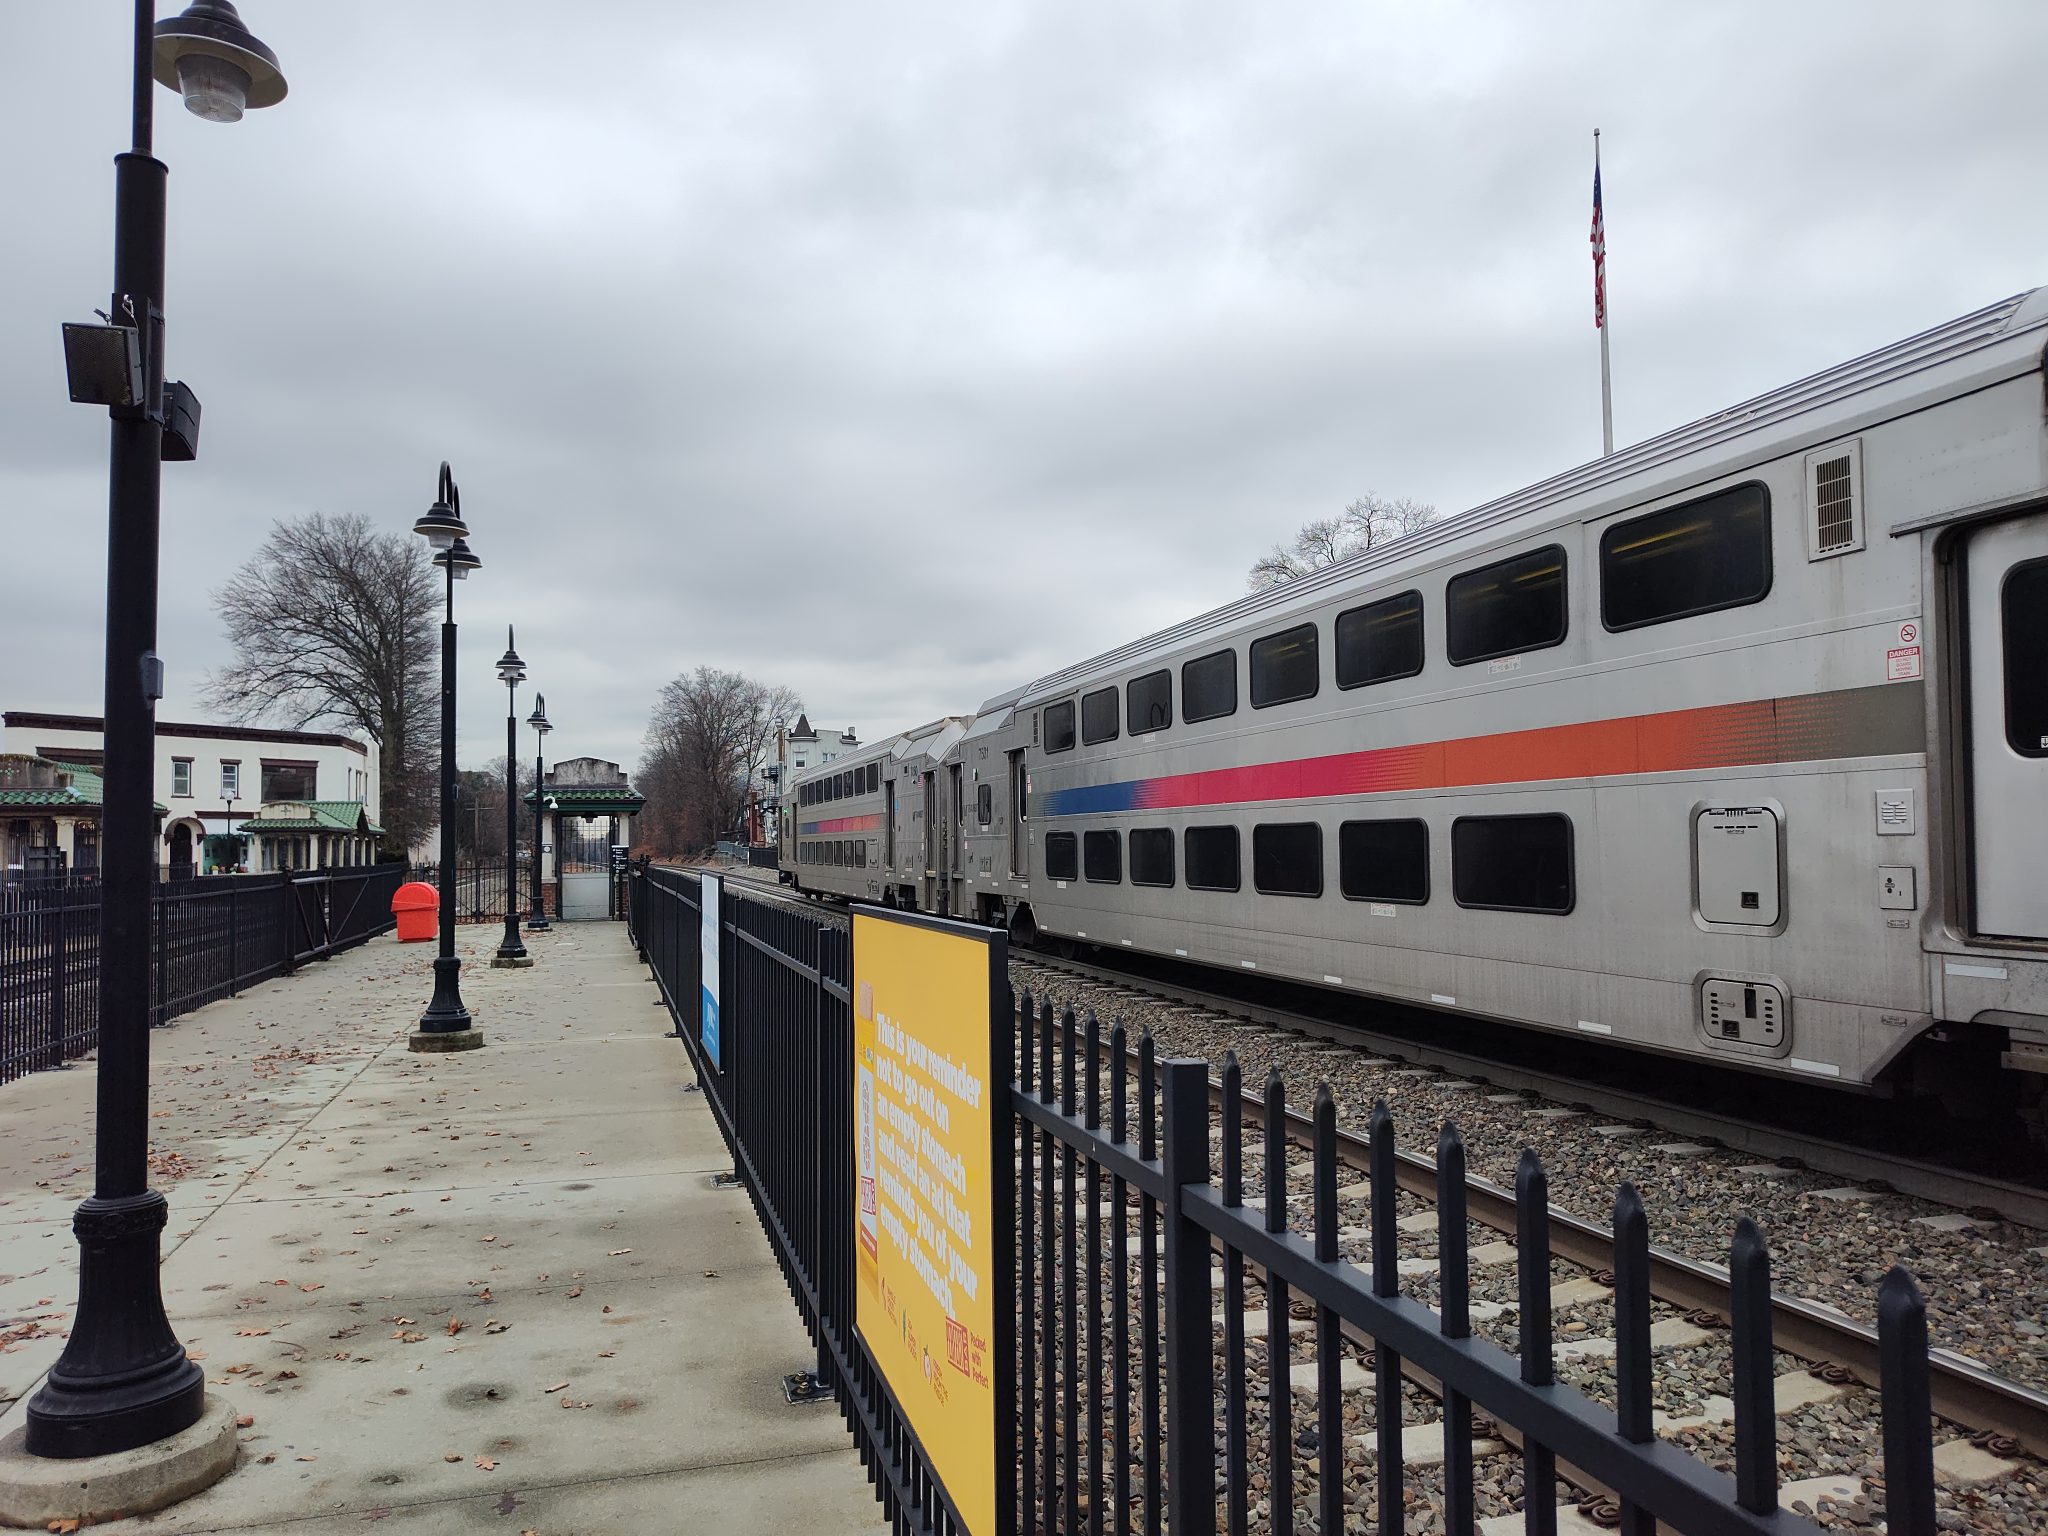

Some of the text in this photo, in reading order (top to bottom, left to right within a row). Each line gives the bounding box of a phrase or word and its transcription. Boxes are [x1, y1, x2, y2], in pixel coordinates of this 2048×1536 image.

[1889, 647, 1918, 658] DANGER
[876, 1011, 895, 1052] This
[896, 1021, 905, 1056] is
[906, 1034, 927, 1071] your
[928, 1048, 981, 1109] reminder
[876, 1054, 949, 1135] not to go out on
[877, 1091, 888, 1121] an
[889, 1103, 921, 1154] empty
[921, 1125, 967, 1197] stomach
[878, 1126, 972, 1249] and read an ad that
[880, 1202, 908, 1260] empty
[880, 1164, 977, 1302] reminds you of your
[970, 1331, 987, 1353] Packed
[971, 1350, 982, 1367] with
[972, 1366, 989, 1390] Perfect
